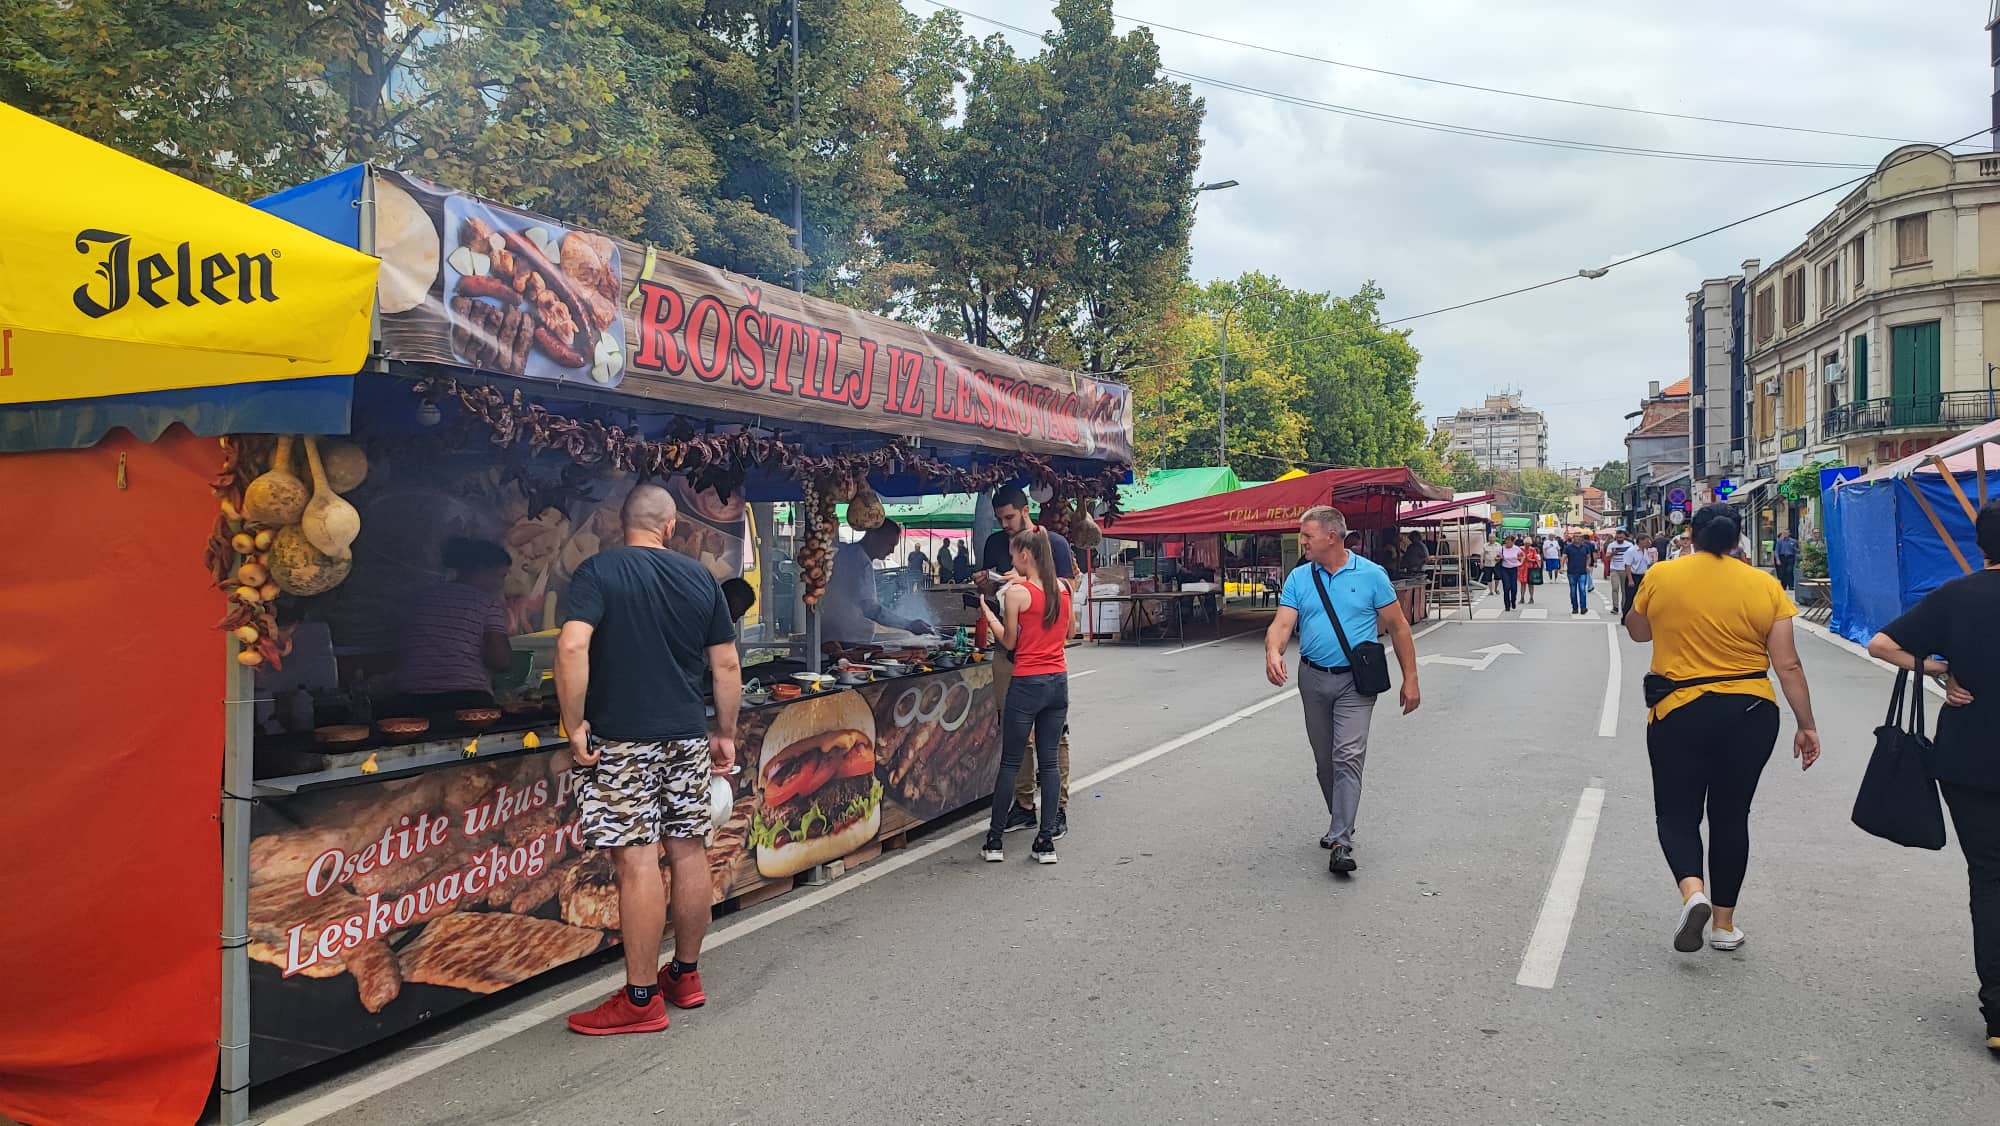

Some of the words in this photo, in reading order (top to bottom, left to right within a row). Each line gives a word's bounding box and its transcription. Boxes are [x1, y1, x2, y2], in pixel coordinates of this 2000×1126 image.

[634, 279, 878, 409] ROŠTILJ
[884, 344, 924, 417] IZ
[932, 356, 1080, 443] LESKOVAC
[283, 832, 547, 979] Leskovačkog
[304, 812, 449, 898] Osetite
[463, 777, 549, 836] ukus
